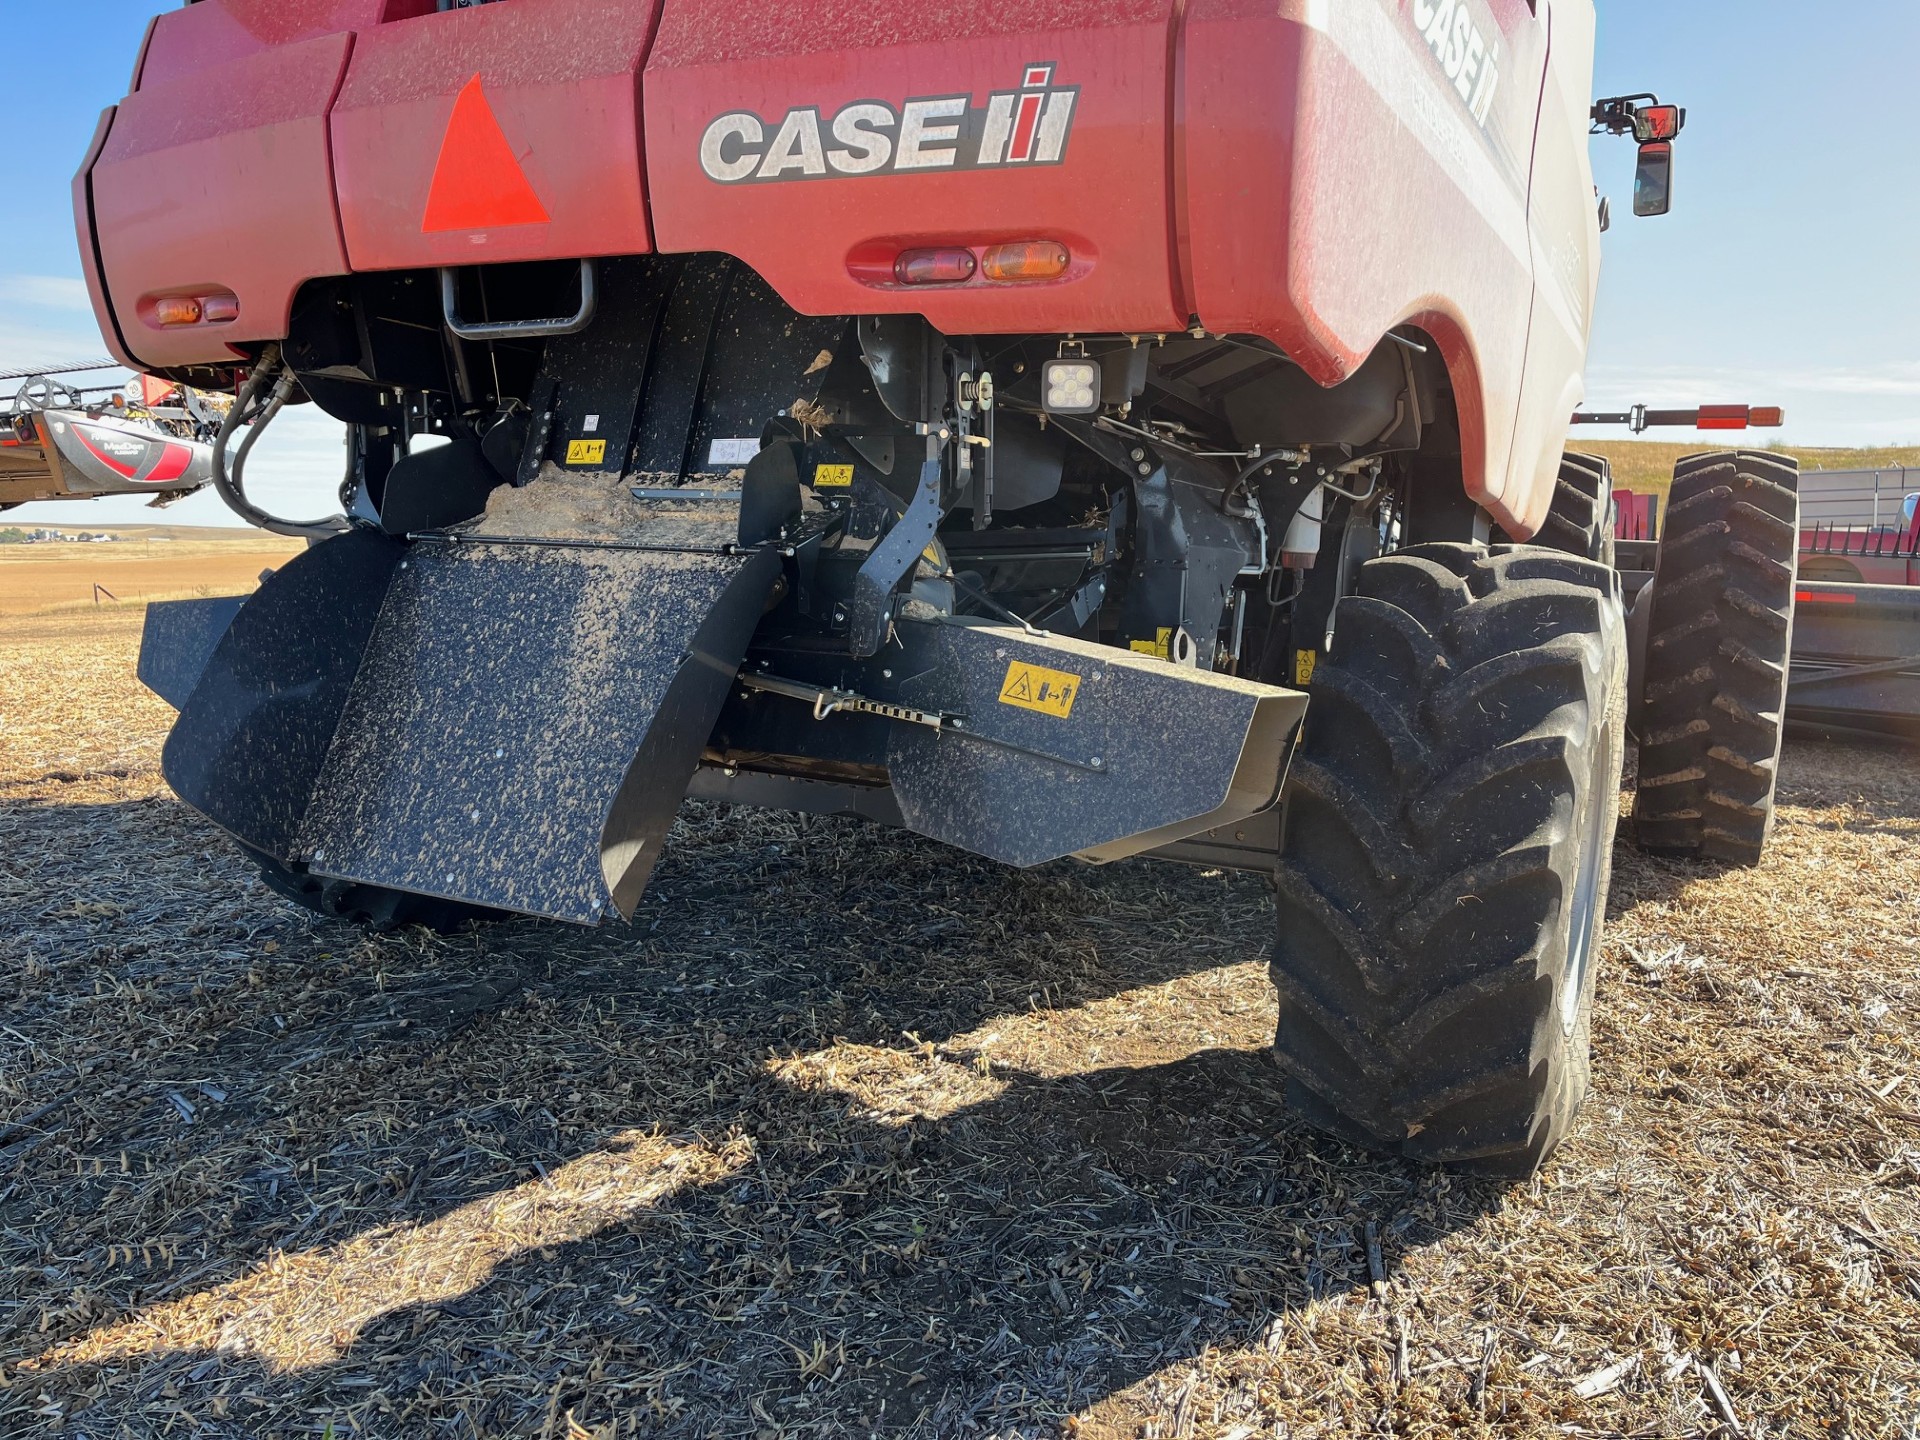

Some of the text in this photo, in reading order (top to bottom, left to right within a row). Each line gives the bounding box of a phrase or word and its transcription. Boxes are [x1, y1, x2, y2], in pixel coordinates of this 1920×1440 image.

[700, 97, 967, 181] CASE
[130, 384, 138, 394] 20
[104, 442, 145, 450] MacDon
